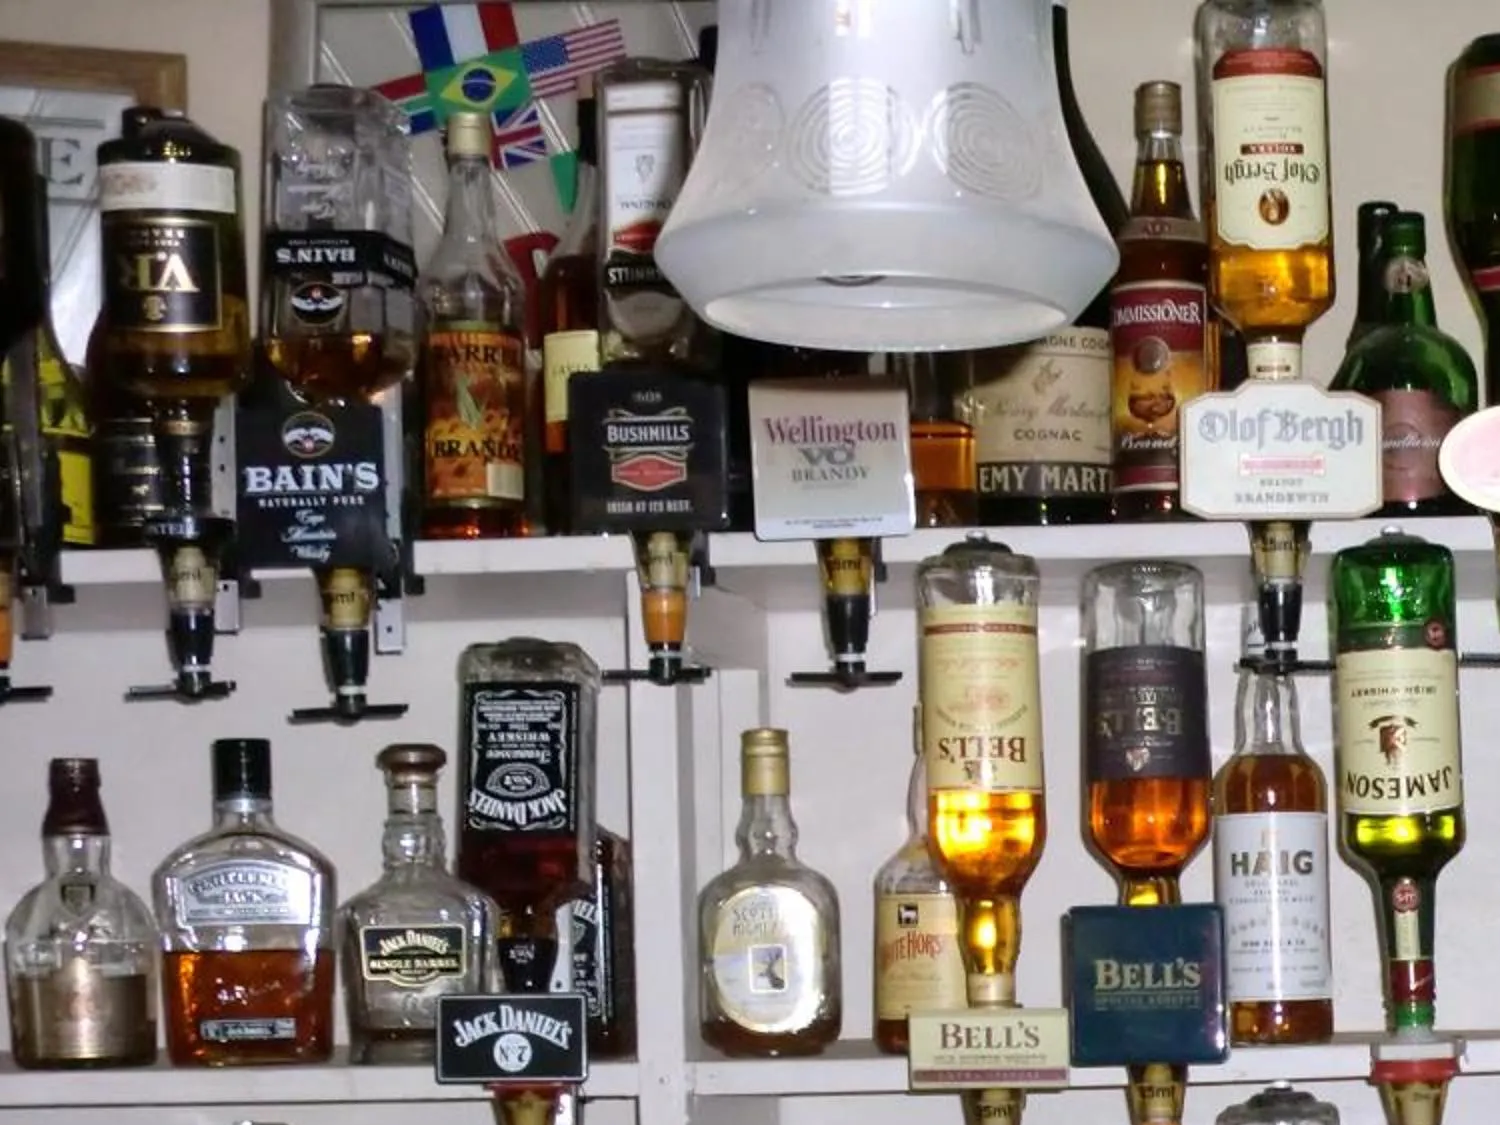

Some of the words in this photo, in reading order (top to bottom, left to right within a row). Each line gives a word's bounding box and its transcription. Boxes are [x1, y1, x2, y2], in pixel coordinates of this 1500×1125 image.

[1114, 301, 1200, 327] OMMISSIONER
[607, 425, 690, 442] BUSHMILLS
[764, 416, 898, 445] Wellington
[1013, 427, 1083, 442] COGNAC
[1199, 411, 1269, 446] Olof
[1274, 409, 1363, 450] Bergh
[800, 448, 855, 465] VO
[244, 462, 380, 493] BAIN'S
[791, 467, 869, 483] BRANDY
[938, 735, 1027, 764] BELL'S
[1347, 764, 1453, 799] JAMESON
[468, 788, 527, 826] DANIEL'S
[527, 788, 567, 820] JACK
[1230, 851, 1314, 878] HAIG
[413, 956, 460, 970] BARREL
[1094, 958, 1202, 991] BELL'S
[453, 1009, 500, 1046] JACK
[500, 1005, 574, 1050] DANIEL'S
[939, 1022, 1041, 1051] BELL'S
